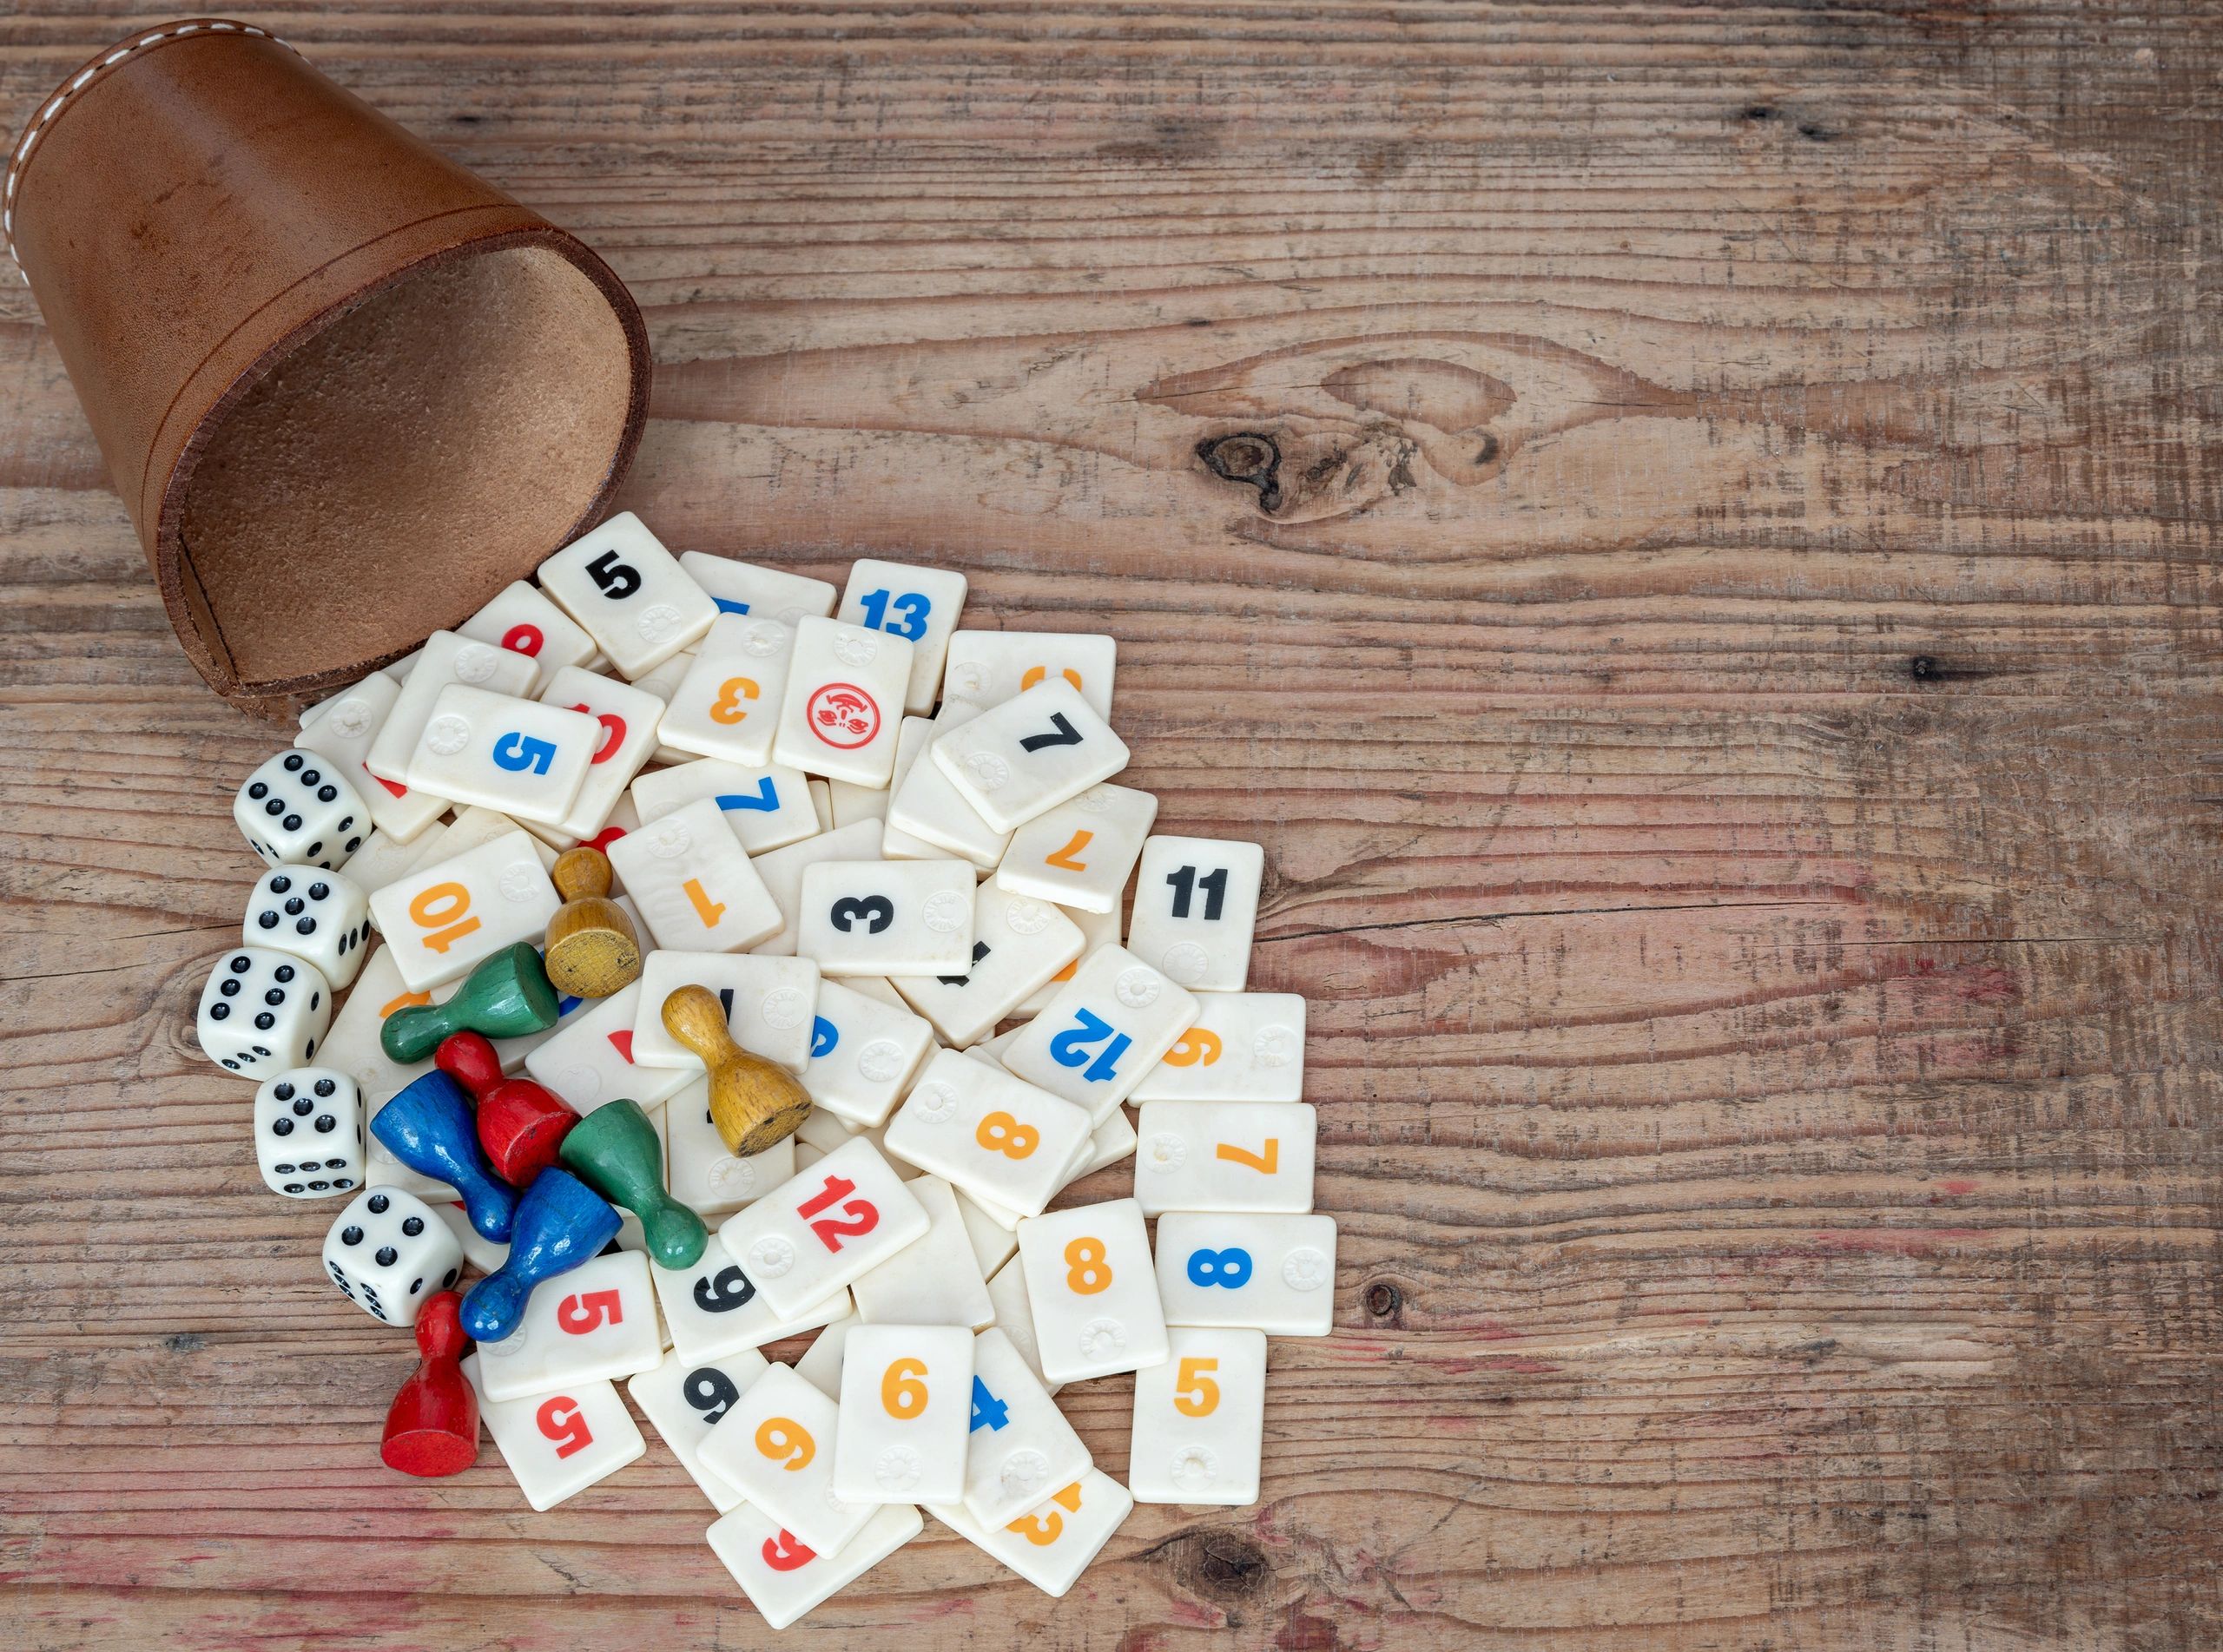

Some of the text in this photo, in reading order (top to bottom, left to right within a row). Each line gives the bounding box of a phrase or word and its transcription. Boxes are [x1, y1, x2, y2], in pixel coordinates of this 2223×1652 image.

[584, 549, 642, 601] 5
[860, 589, 932, 643] 13
[709, 676, 761, 727] 3
[492, 731, 557, 776] 5
[1019, 712, 1084, 754] 7
[715, 776, 781, 813] 7
[1045, 829, 1094, 872] 7
[408, 881, 482, 954] 10
[683, 878, 727, 929] 1
[830, 895, 894, 935] 3
[1165, 865, 1229, 921] 11
[1049, 1007, 1132, 1083] 12
[975, 1110, 1040, 1161] 8
[1216, 1138, 1279, 1175] 7
[796, 1175, 880, 1254] 12
[1064, 1236, 1113, 1296] 8
[1186, 1247, 1253, 1290] 8
[557, 1289, 623, 1335] 5
[683, 1367, 741, 1425] 9
[881, 1357, 929, 1420] 6
[968, 1373, 1010, 1433] 4
[1173, 1357, 1220, 1418] 5
[536, 1396, 593, 1459] 5
[755, 1417, 816, 1471] 9
